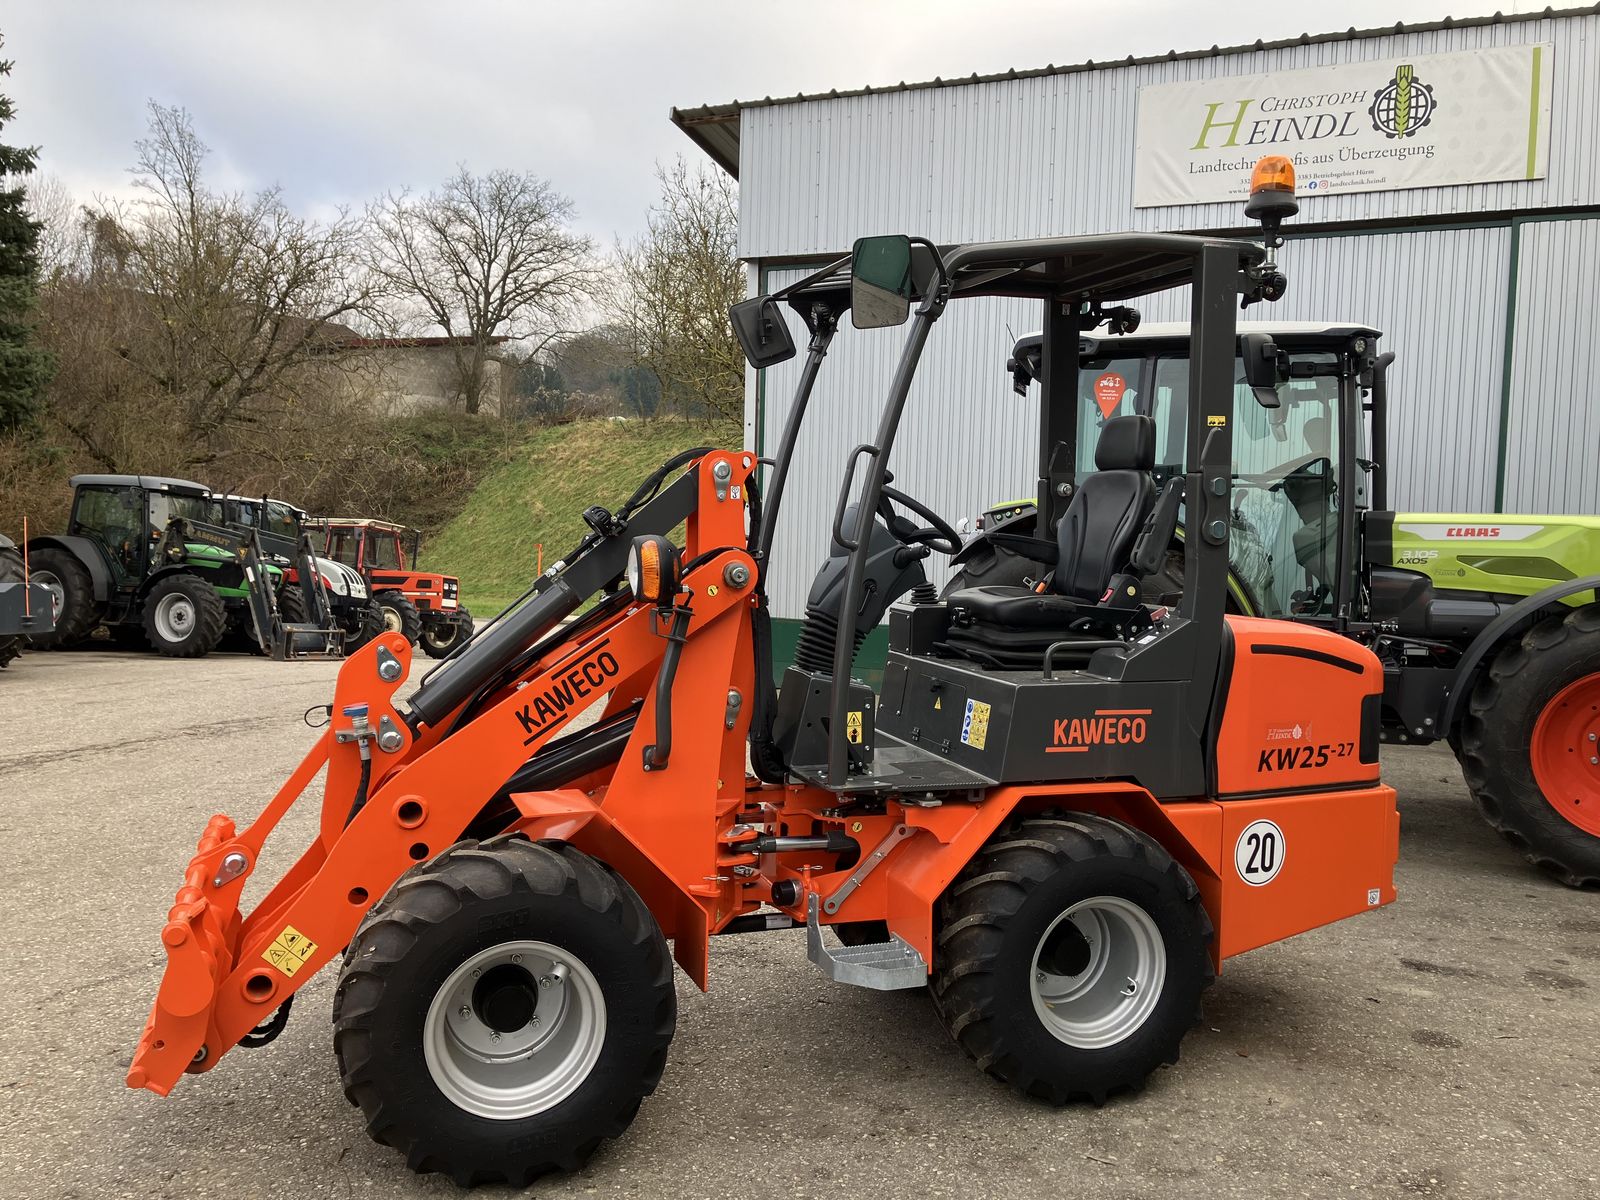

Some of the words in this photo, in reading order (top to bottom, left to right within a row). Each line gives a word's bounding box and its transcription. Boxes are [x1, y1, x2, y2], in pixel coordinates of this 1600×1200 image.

[1260, 90, 1368, 114] CHRISTOPH
[1189, 98, 1360, 151] HEINDL
[1189, 156, 1261, 174] Landtechn
[1312, 153, 1334, 165] aus
[1339, 145, 1435, 163] Überzeugung
[1297, 173, 1312, 181] 3383
[1446, 527, 1501, 537] CLAAS
[1396, 557, 1428, 565] AXOS
[1401, 550, 1439, 558] 3.105
[514, 651, 620, 734] KAWECO
[1053, 717, 1147, 746] KAWECO
[1244, 832, 1276, 874] 20
